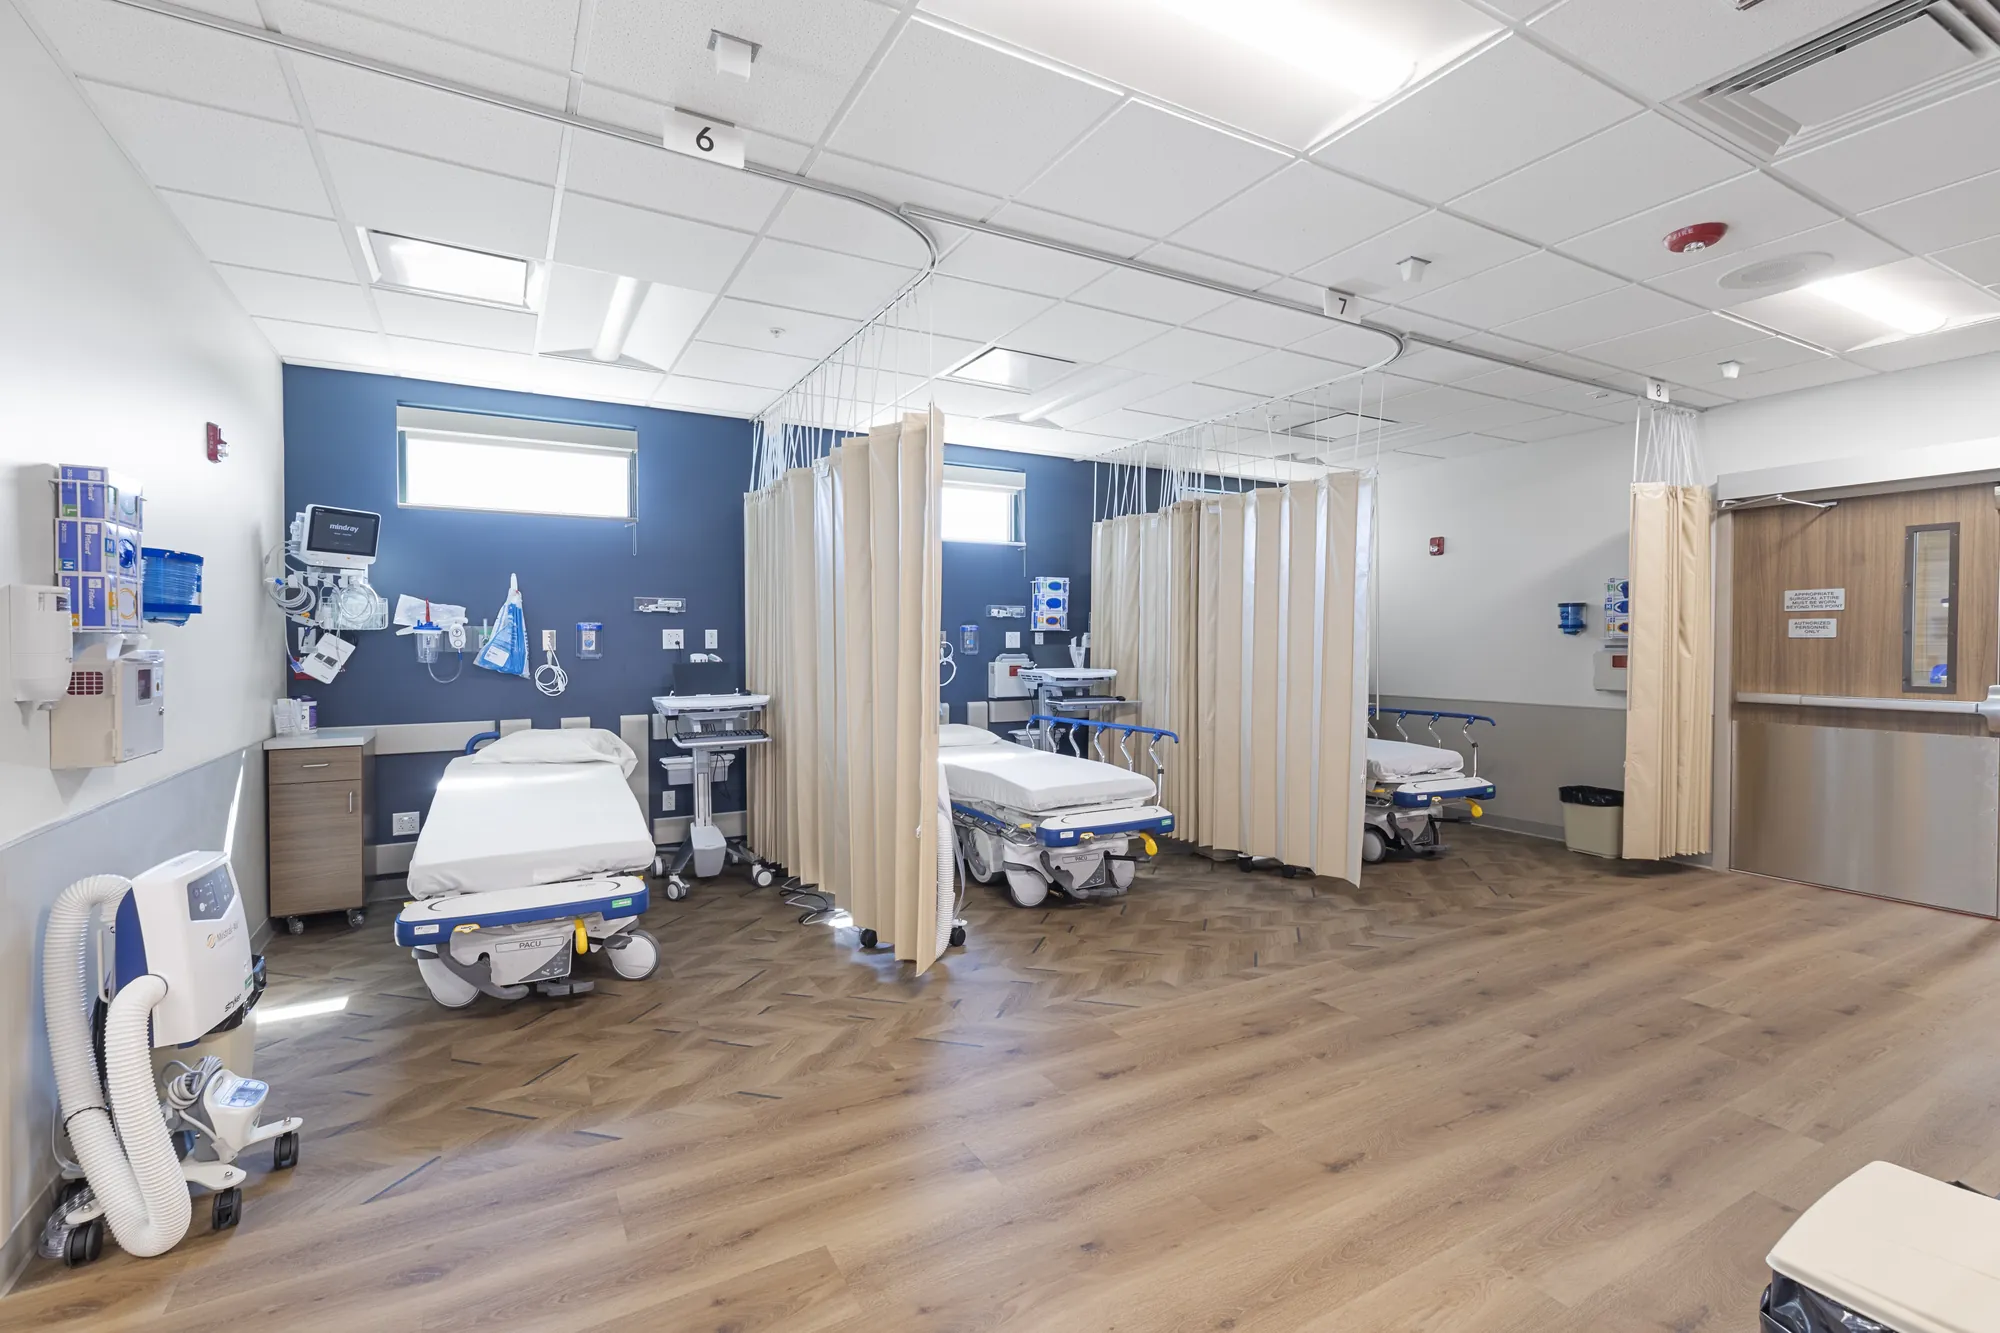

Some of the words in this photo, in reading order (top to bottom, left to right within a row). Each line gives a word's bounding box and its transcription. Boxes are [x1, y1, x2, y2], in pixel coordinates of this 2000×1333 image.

[696, 126, 714, 152] 6
[1338, 297, 1347, 315] 7
[1656, 383, 1662, 397] 8
[329, 523, 360, 533] mindray
[63, 561, 74, 570] M
[519, 940, 542, 949] PACU
[224, 993, 242, 1012] stryker
